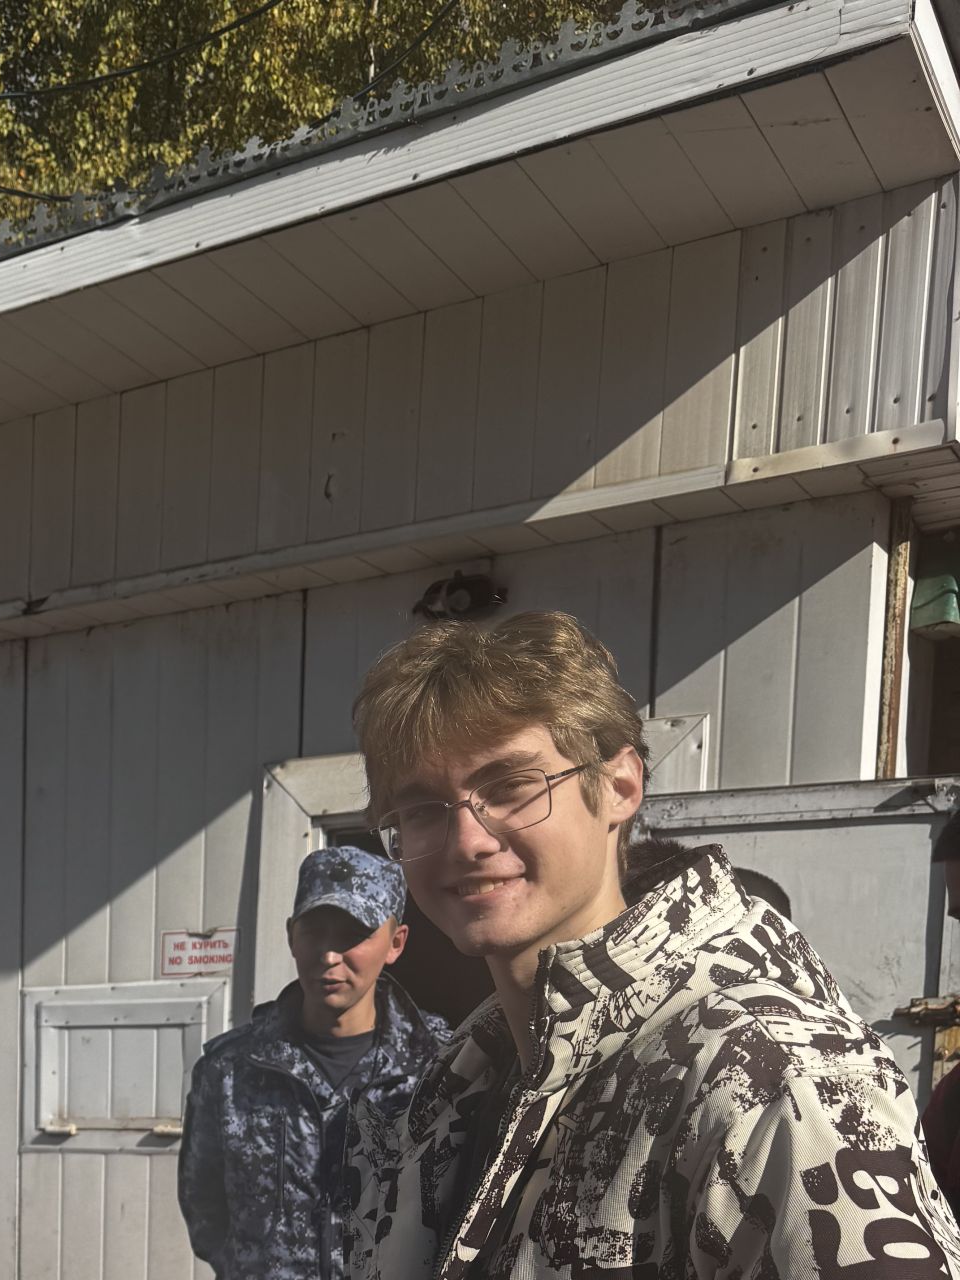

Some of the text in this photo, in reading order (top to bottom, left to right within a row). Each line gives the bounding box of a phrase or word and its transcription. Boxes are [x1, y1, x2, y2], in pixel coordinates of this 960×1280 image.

[173, 939, 230, 951] НЕ КУРИТЬ
[168, 953, 234, 966] NO SMOKING
